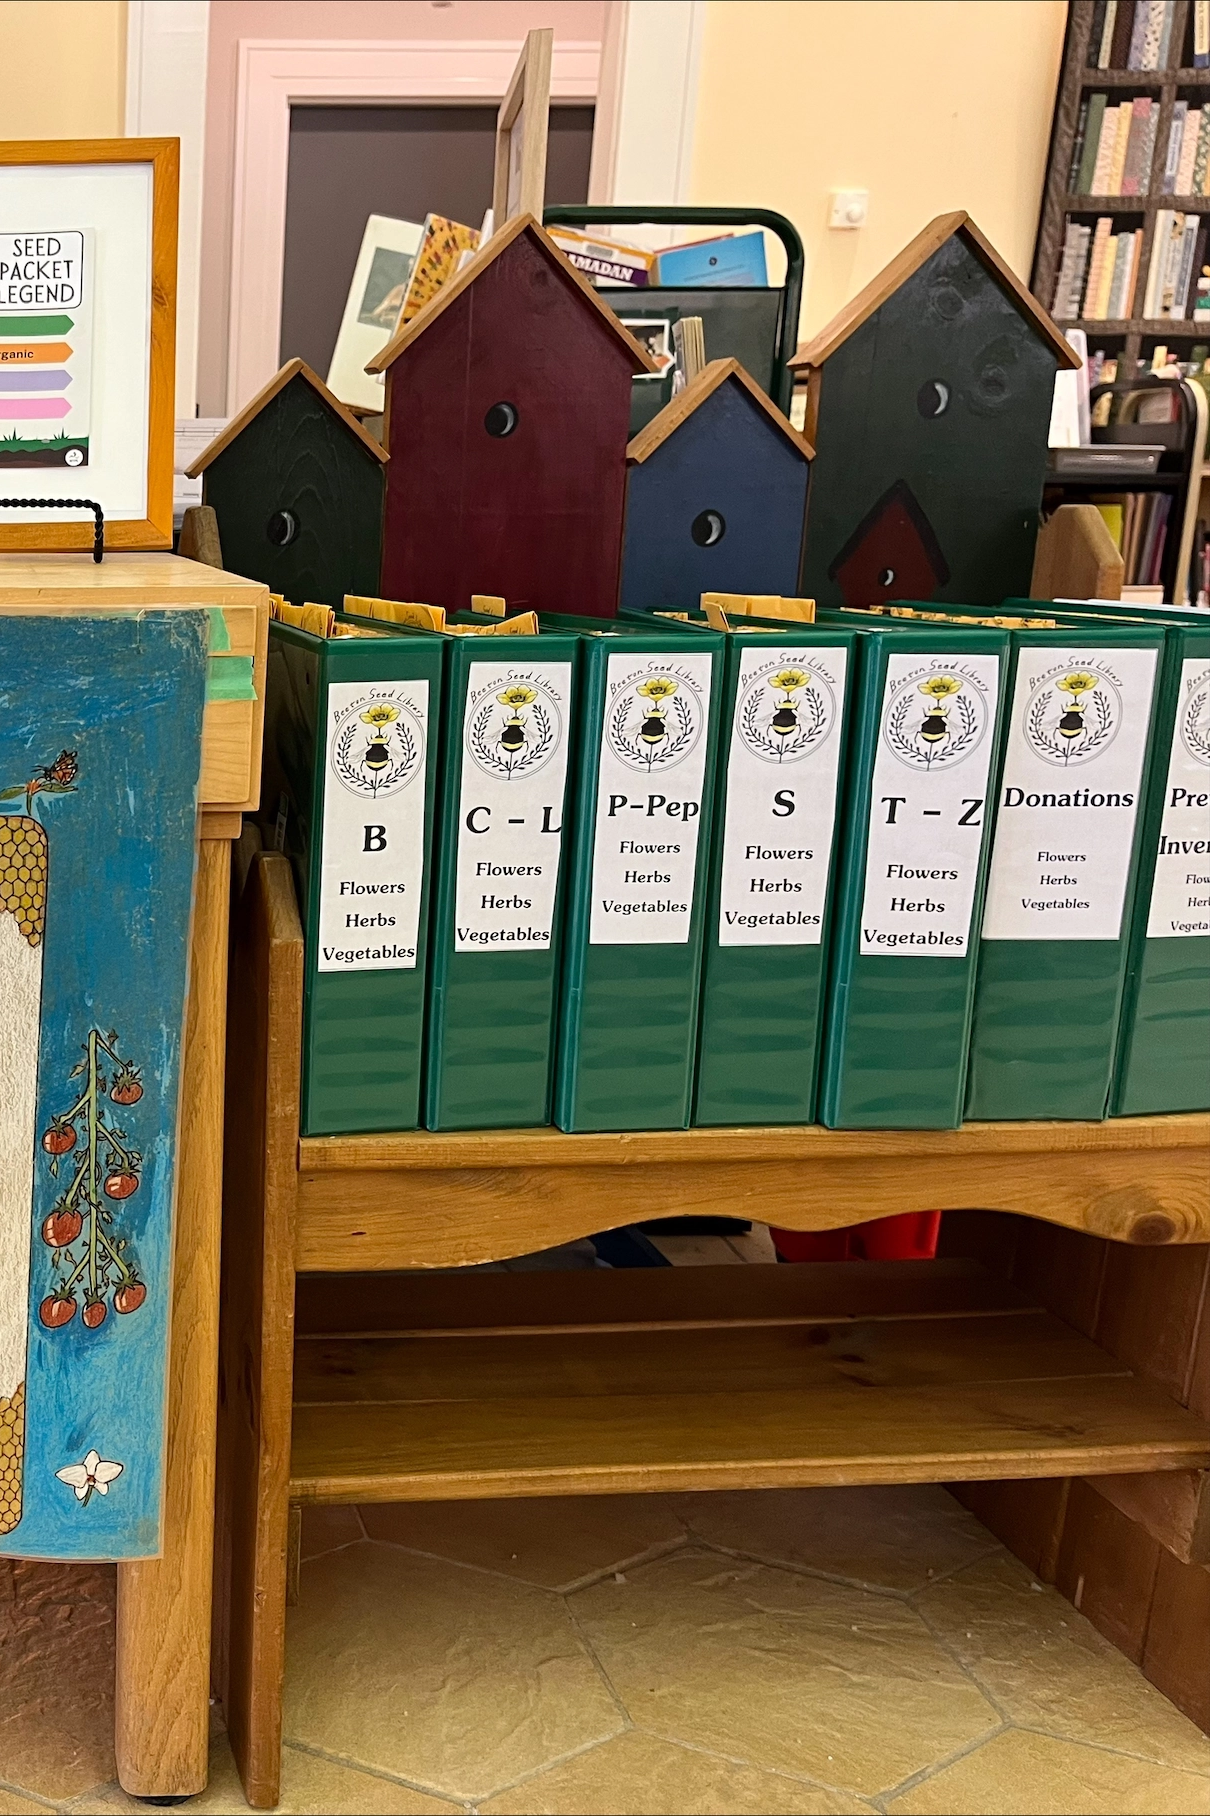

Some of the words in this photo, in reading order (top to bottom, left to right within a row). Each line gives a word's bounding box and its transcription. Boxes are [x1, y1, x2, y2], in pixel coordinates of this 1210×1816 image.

[12, 237, 61, 257] SEED
[0, 260, 74, 281] PACKET
[564, 250, 634, 281] AMADAN
[771, 789, 796, 817] S
[1003, 787, 1134, 807] Donations
[1170, 788, 1210, 807] Pre
[881, 797, 907, 824] T
[957, 799, 984, 826] Z
[466, 806, 492, 834] C
[540, 806, 562, 833] L
[362, 825, 388, 852] B
[619, 840, 681, 854] Flowers
[745, 845, 814, 860] Flowers
[1037, 851, 1087, 862] Flowers
[475, 862, 542, 876] Flowers
[624, 870, 671, 883] Herbs
[886, 864, 959, 880] Flowers
[749, 878, 803, 893] Herbs
[1039, 874, 1078, 885] Herbs
[339, 881, 406, 895] Flowers
[481, 894, 532, 909] Herbs
[602, 899, 688, 915] Vegetables
[890, 897, 945, 913] Herbs
[1021, 898, 1090, 911] Vegetables
[345, 912, 396, 928] Herbs
[724, 911, 821, 928] Vegetables
[1170, 920, 1210, 933] Vegeta
[457, 927, 550, 945] Vegetables
[863, 929, 964, 947] Vegetables
[322, 944, 415, 963] Vegetables
